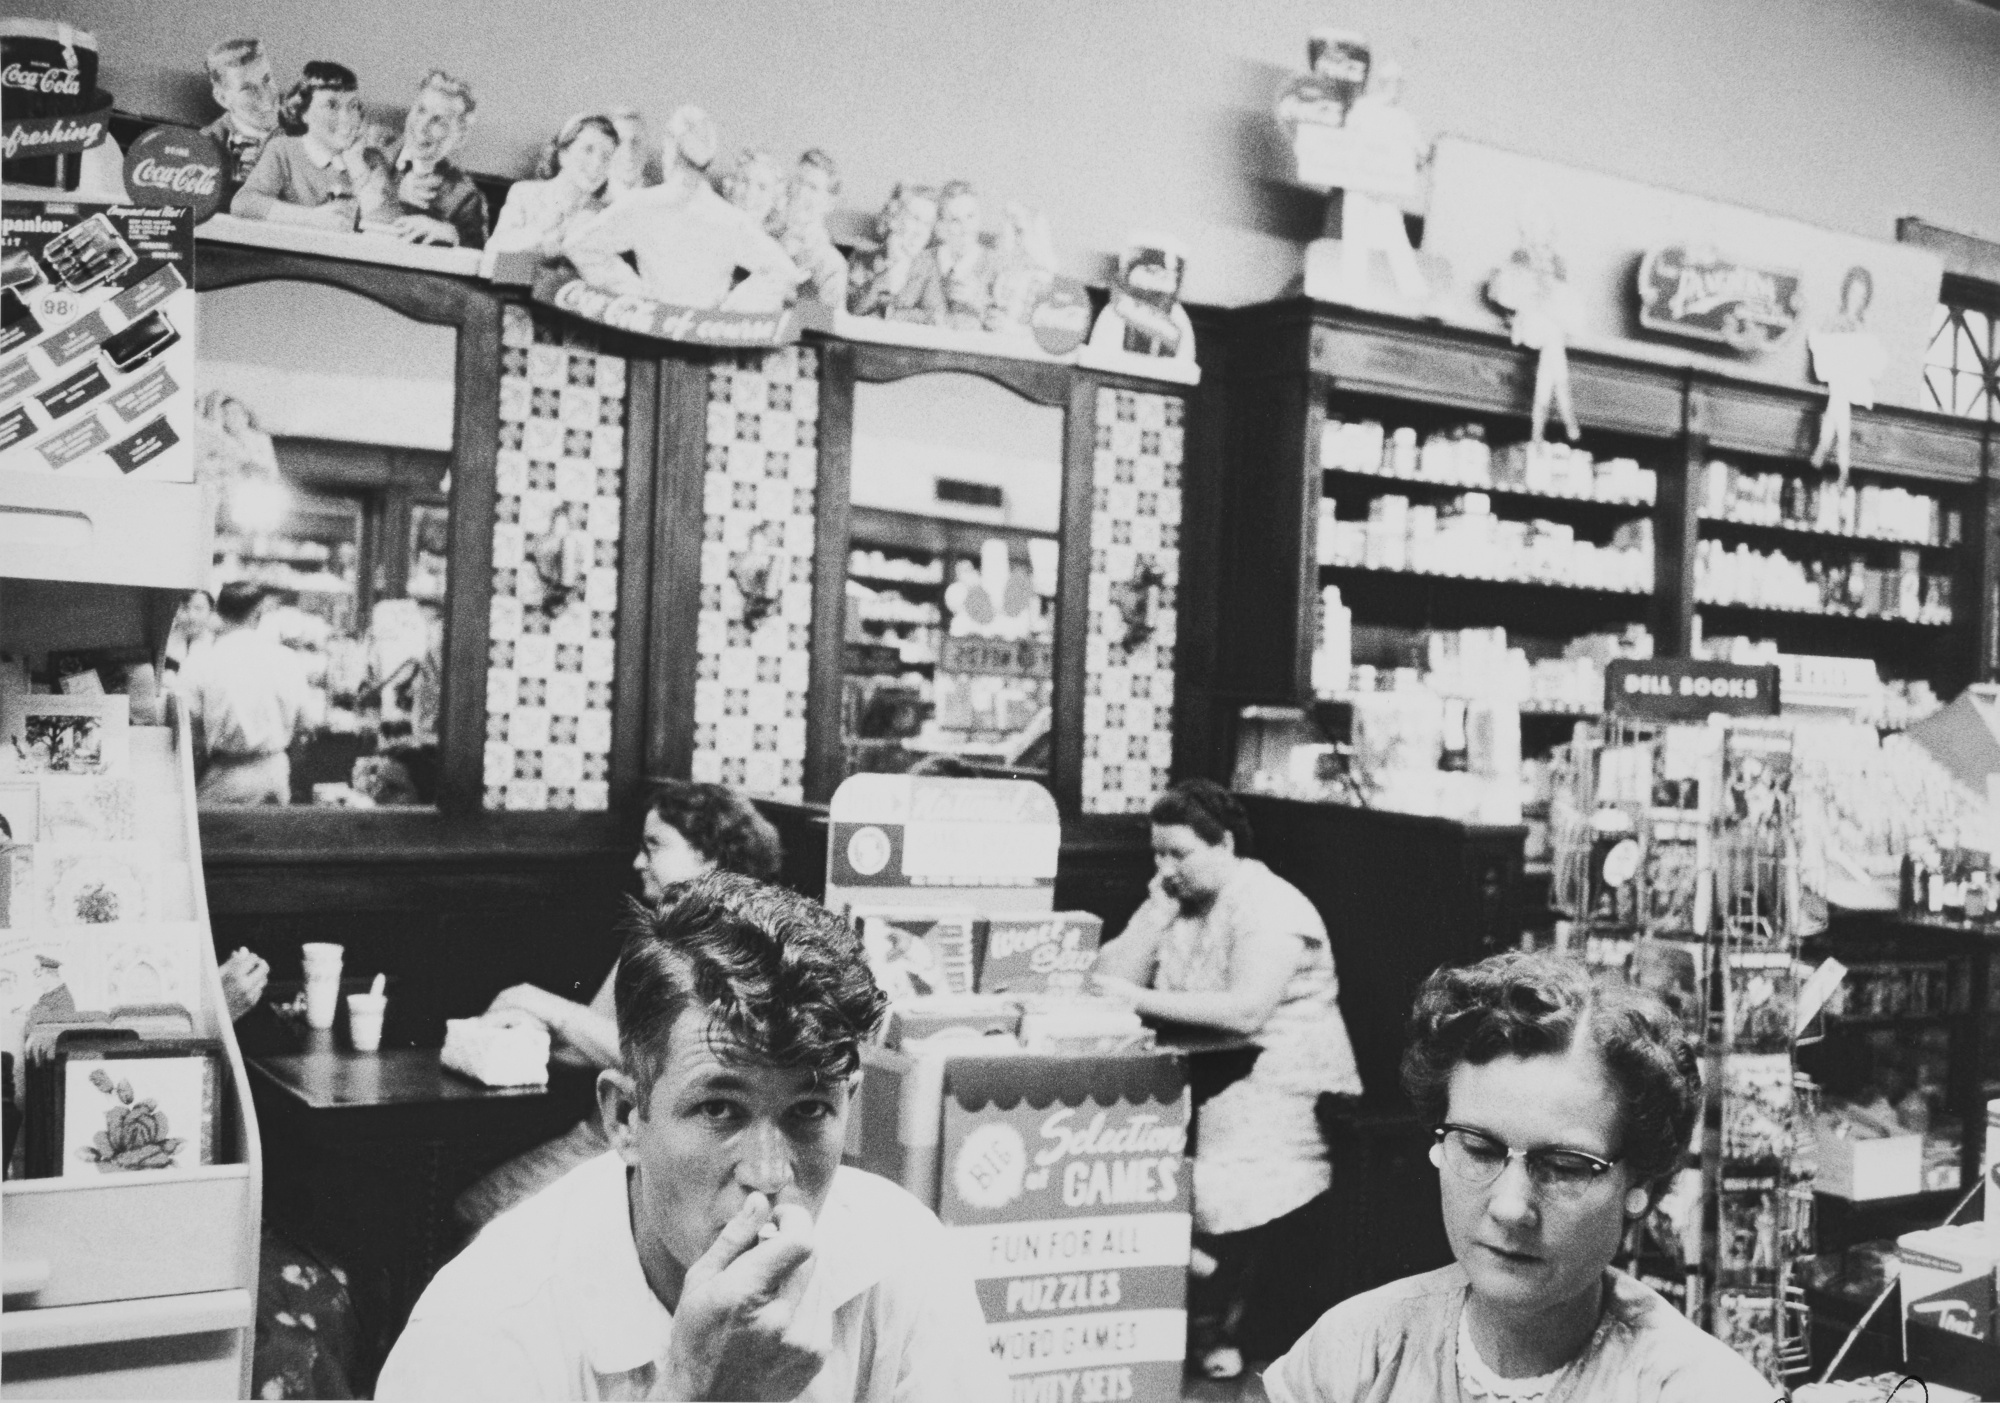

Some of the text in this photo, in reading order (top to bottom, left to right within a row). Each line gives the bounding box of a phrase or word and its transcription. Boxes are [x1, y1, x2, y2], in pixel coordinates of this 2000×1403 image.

[2, 63, 80, 95] Coca-Cola
[132, 158, 220, 195] Coca-Cola
[1624, 674, 1758, 699] DELL BOOKS
[1034, 1107, 1186, 1166] Selection
[1064, 1156, 1179, 1207] GAMES
[990, 1226, 1141, 1263] FUN FOR ALL
[1007, 1271, 1121, 1314] PUZZLES
[989, 1321, 1138, 1361] WORD GAMES
[1081, 1366, 1134, 1403] SETS
